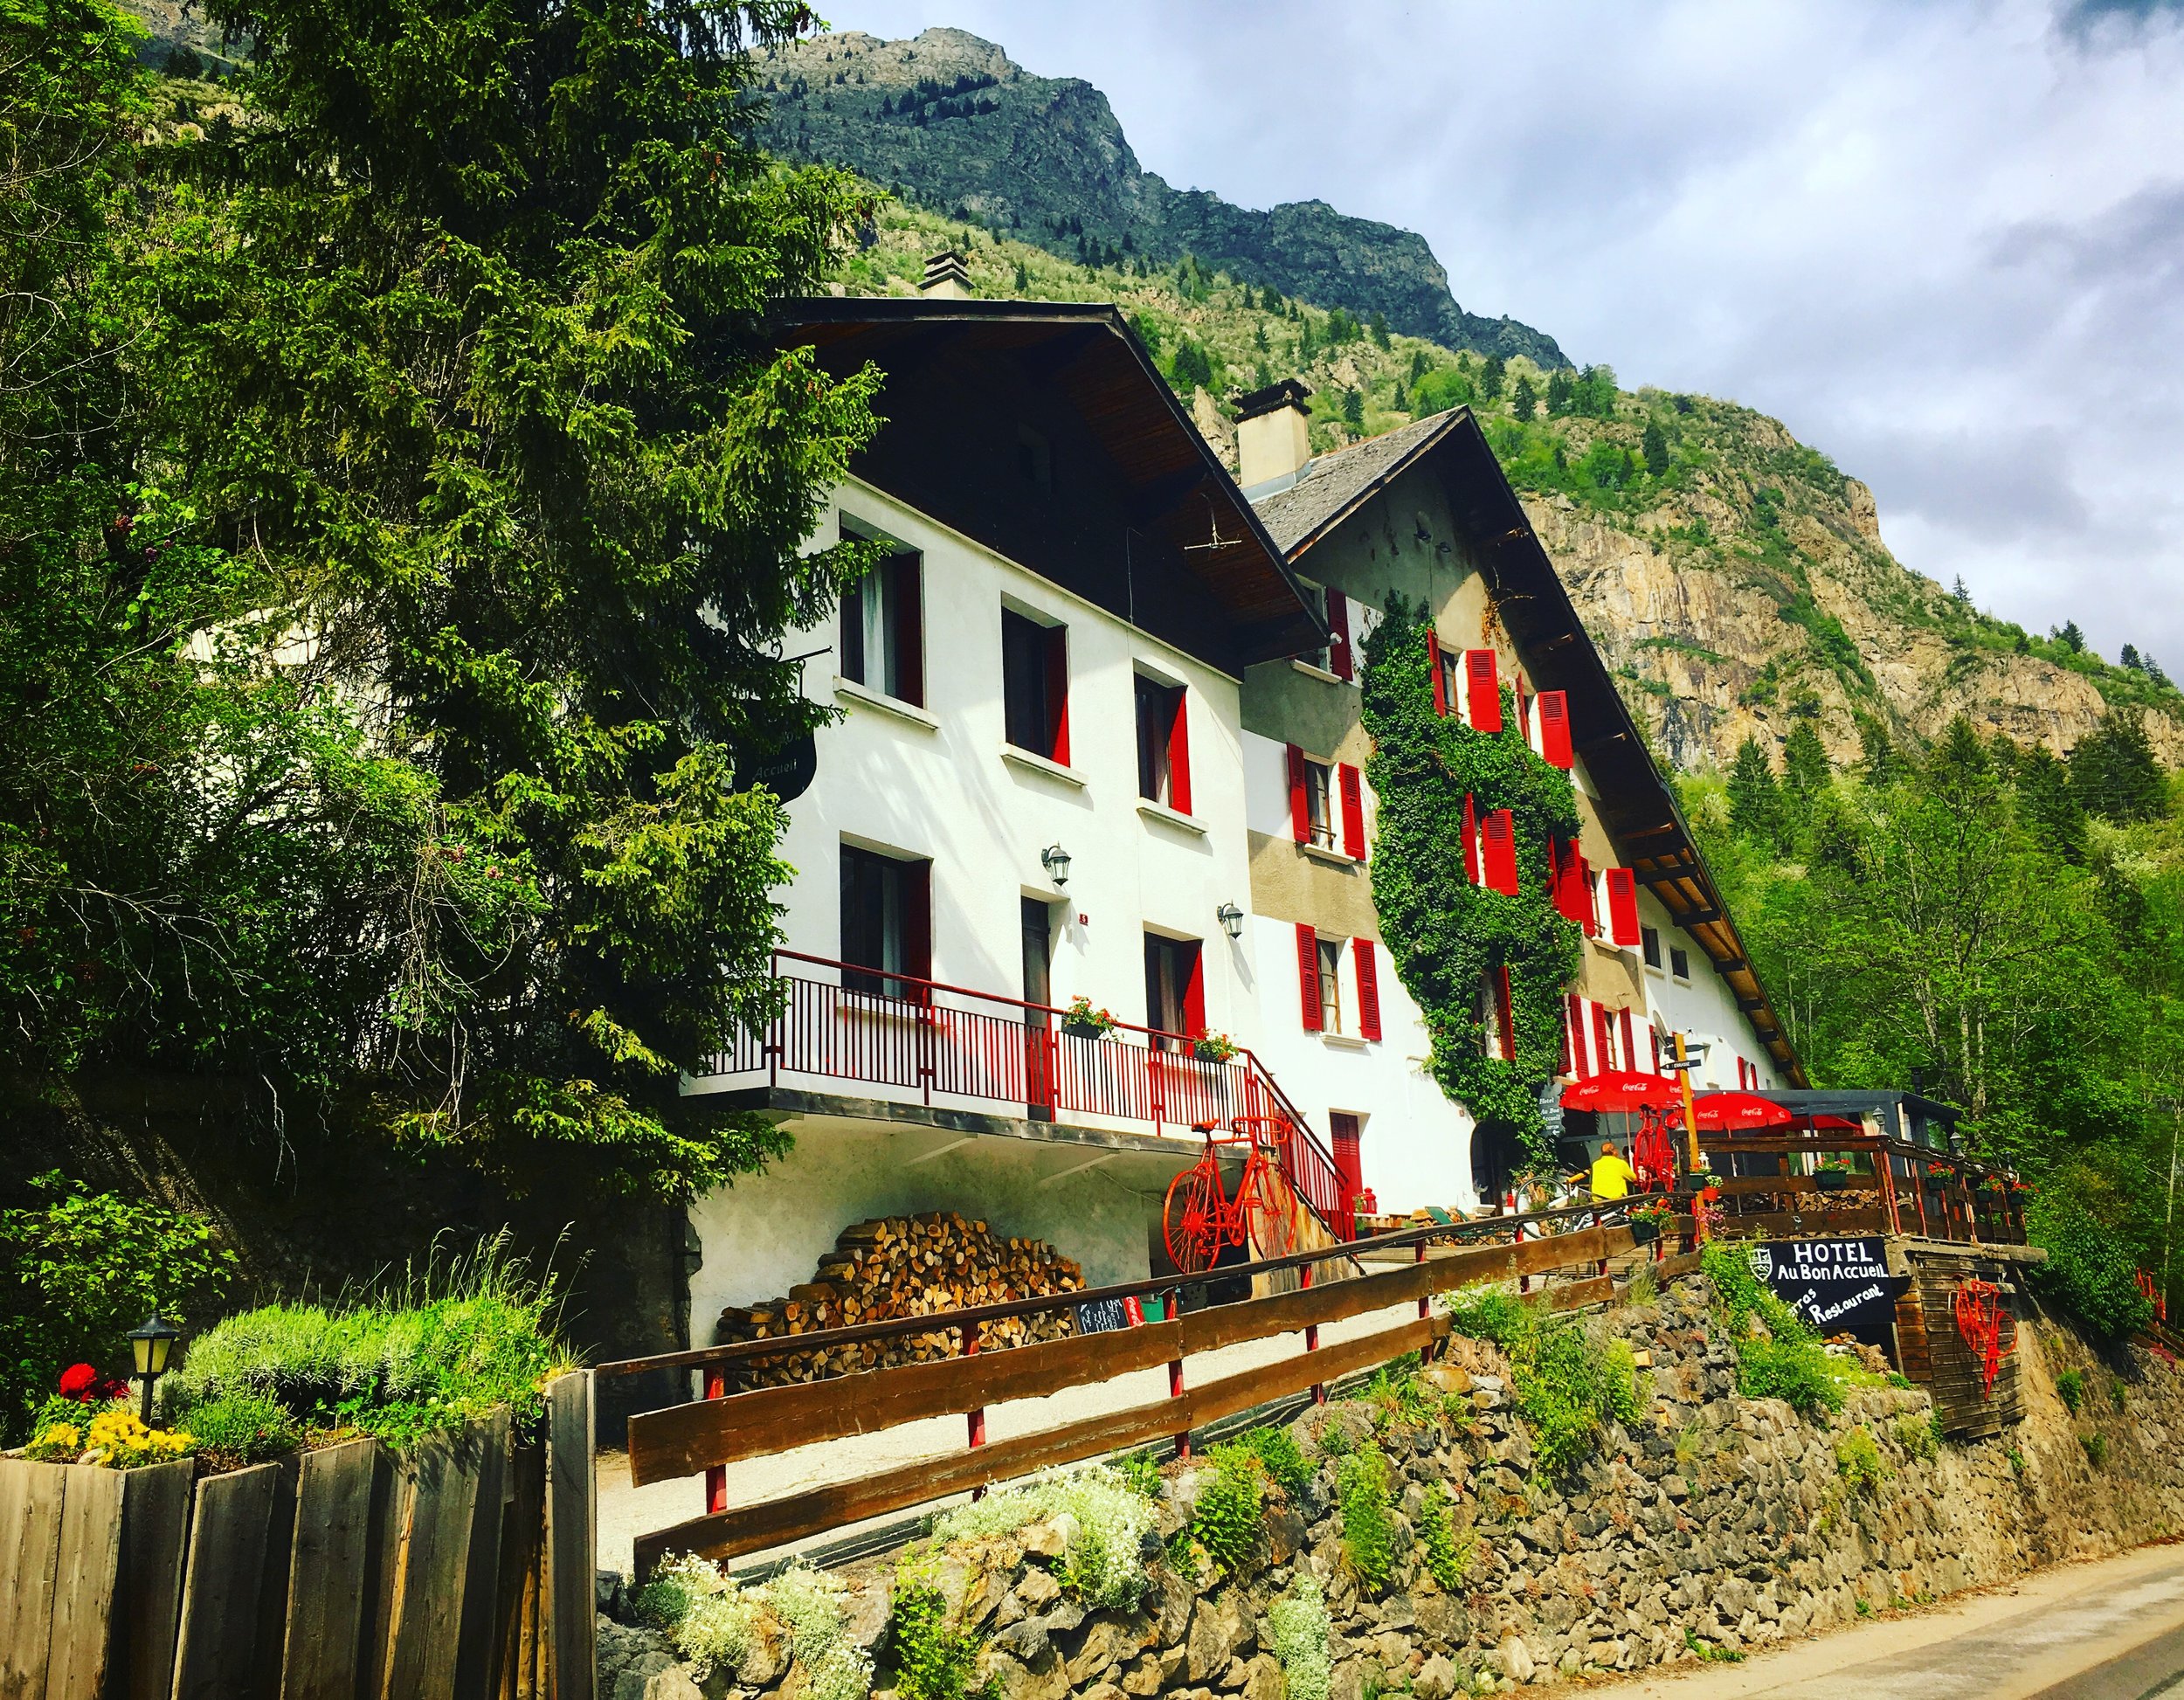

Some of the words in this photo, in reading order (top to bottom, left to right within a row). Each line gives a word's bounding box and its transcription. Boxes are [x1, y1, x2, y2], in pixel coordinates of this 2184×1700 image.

[1793, 1241, 1874, 1263] HOTEL
[1778, 1264, 1799, 1280] Au
[1800, 1263, 1831, 1281] Bon
[1808, 1283, 1884, 1324] Restaurant
